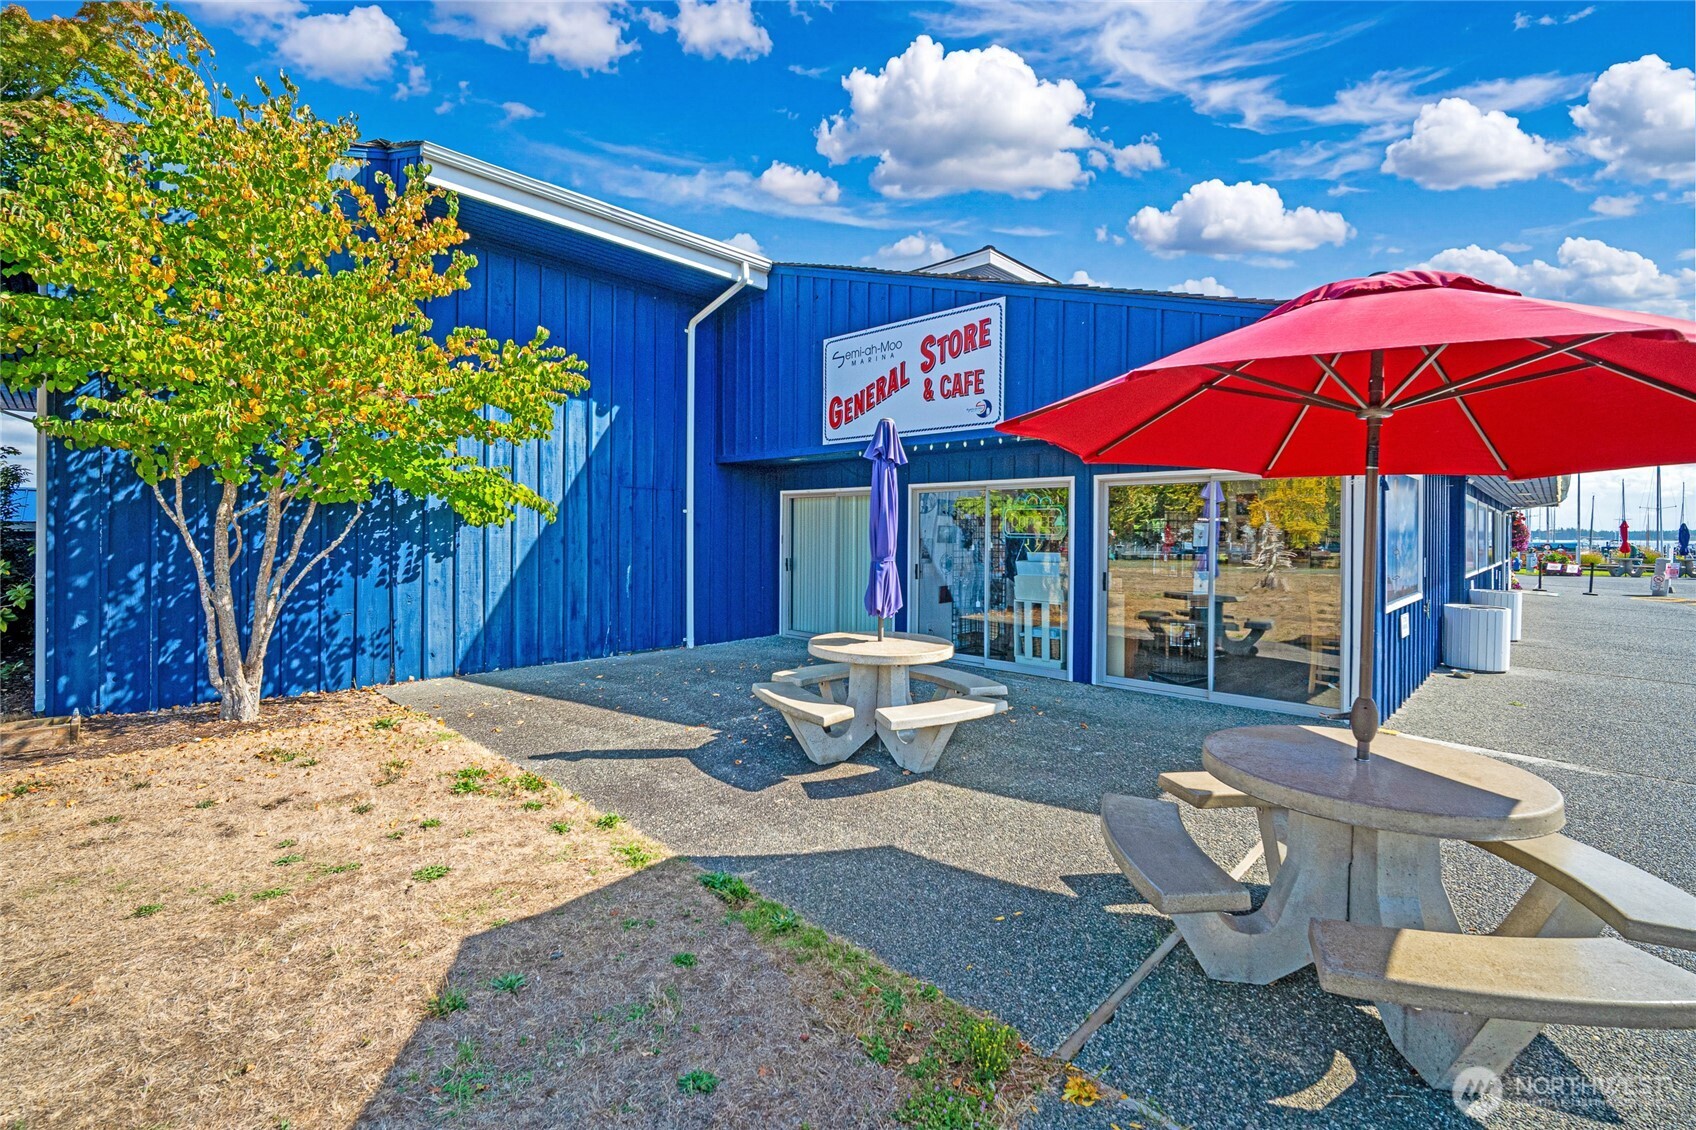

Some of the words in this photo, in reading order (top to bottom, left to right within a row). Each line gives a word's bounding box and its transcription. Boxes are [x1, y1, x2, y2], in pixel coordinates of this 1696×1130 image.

[832, 340, 903, 368] Semi-ah-Moo
[851, 353, 895, 366] MARINA
[828, 361, 910, 430] GENERAL
[920, 317, 992, 373] STORE
[923, 377, 935, 402] &
[940, 369, 985, 400] CAFE
